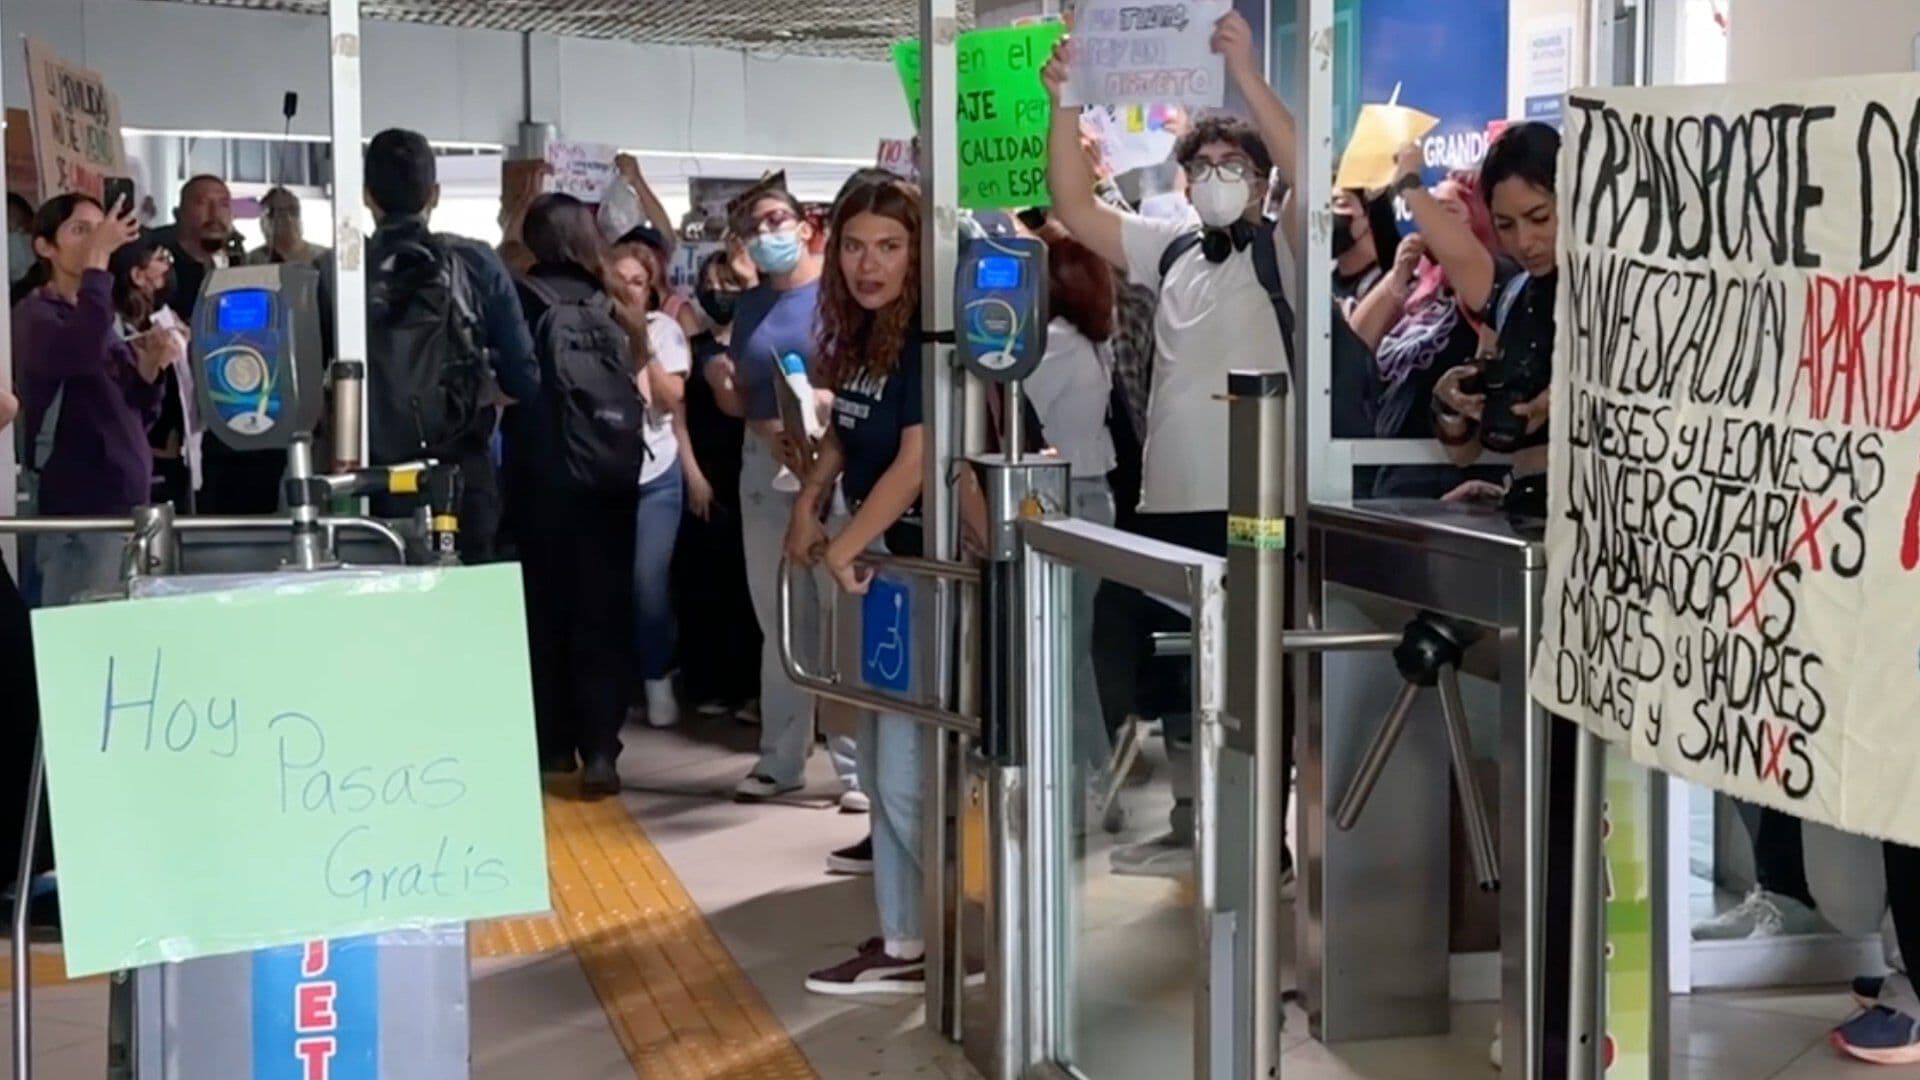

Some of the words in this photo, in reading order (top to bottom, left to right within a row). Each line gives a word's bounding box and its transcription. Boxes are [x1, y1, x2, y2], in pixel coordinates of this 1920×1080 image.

[1008, 36, 1032, 70] el
[957, 90, 997, 122] AJE
[1014, 98, 1046, 128] per
[961, 135, 1044, 167] CALIDAD
[1008, 167, 1047, 197] ESP
[1568, 95, 1836, 267] TRANSPORTE
[1787, 273, 1920, 432] APARTID
[1699, 416, 1885, 504] LEONESAS
[101, 647, 238, 757] Hoy
[1702, 626, 1826, 734] PADRES
[268, 712, 467, 814] Pasas
[1677, 699, 1815, 799] SANXS
[324, 824, 510, 909] Gratis
[295, 938, 337, 1080] JET
